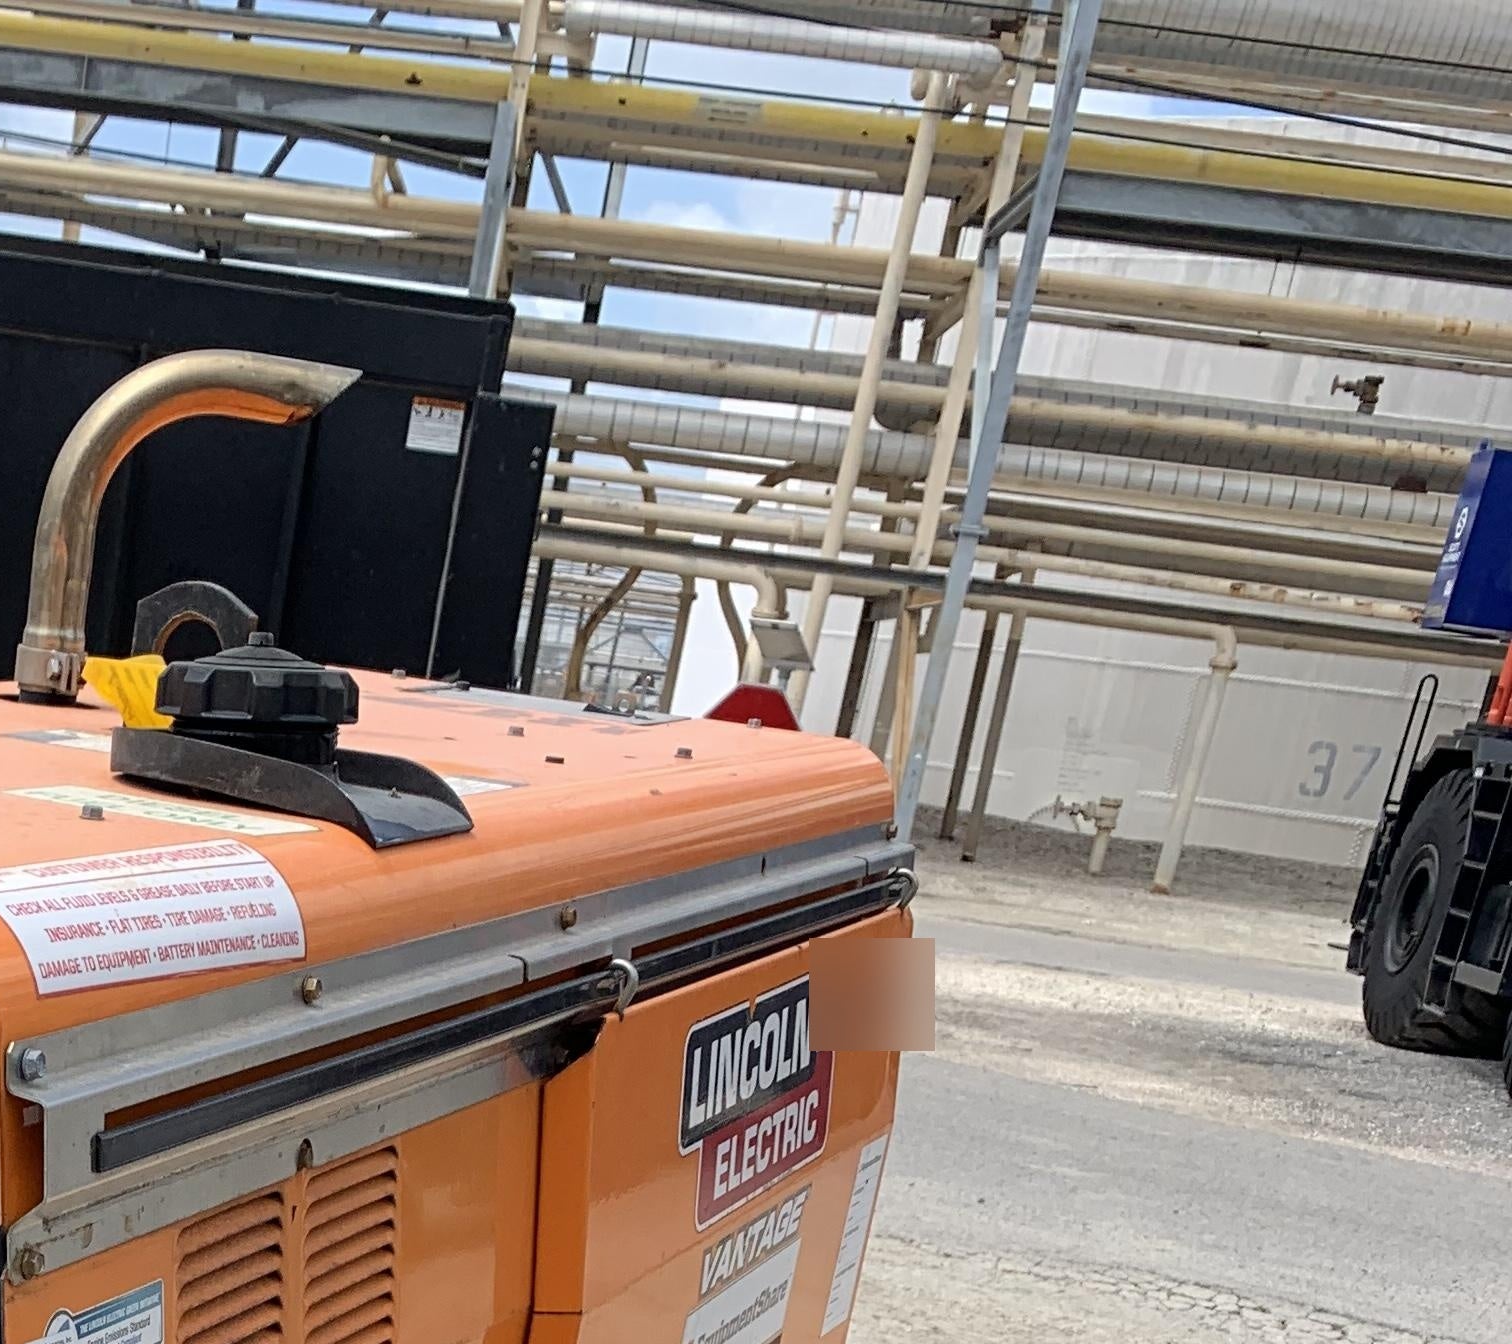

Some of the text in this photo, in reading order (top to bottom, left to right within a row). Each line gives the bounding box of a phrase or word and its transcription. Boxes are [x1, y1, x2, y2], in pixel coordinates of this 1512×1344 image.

[23, 843, 253, 877] CUSTOMER RESPONSIBILITY
[6, 901, 47, 916] CHECK
[44, 898, 66, 911] ALL
[61, 895, 96, 909] FLUID
[91, 890, 129, 905] LEVELS
[136, 885, 177, 900] GREASE
[173, 882, 203, 896] DAILY
[200, 878, 235, 893] BEFORE
[234, 876, 263, 890] START
[261, 875, 276, 888] UP
[44, 902, 277, 943] INSURANCE FLAT TIRES TIRE DAMAGE REFUELING
[38, 930, 301, 979] DAMAGE TO EQUIPMENT BATTERY MAINTENANCE CLEANING
[688, 998, 810, 1129] LINCOLN
[713, 1089, 820, 1201] ELECTRIC
[700, 1190, 810, 1296] VANTAGE
